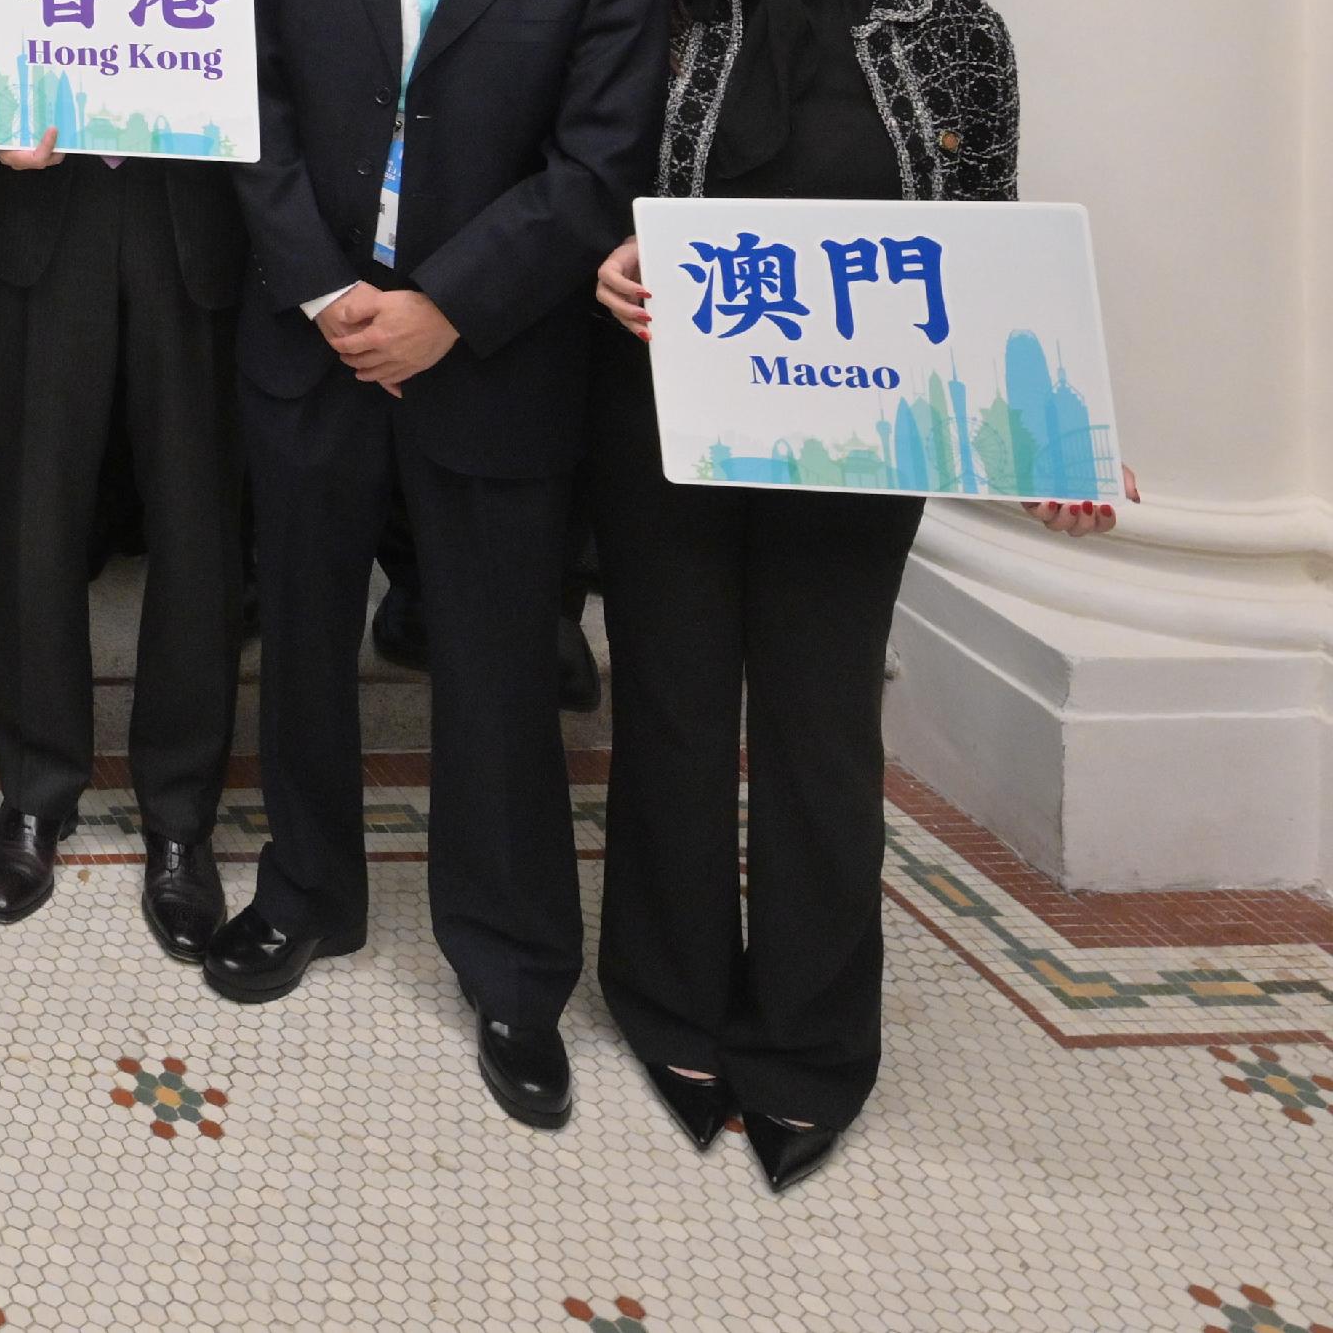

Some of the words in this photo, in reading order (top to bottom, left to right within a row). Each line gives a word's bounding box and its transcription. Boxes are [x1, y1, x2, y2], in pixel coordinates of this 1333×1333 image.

[27, 40, 119, 77] Hong
[128, 42, 224, 80] Kong
[679, 232, 950, 345] 澳門
[750, 354, 901, 391] Macao
